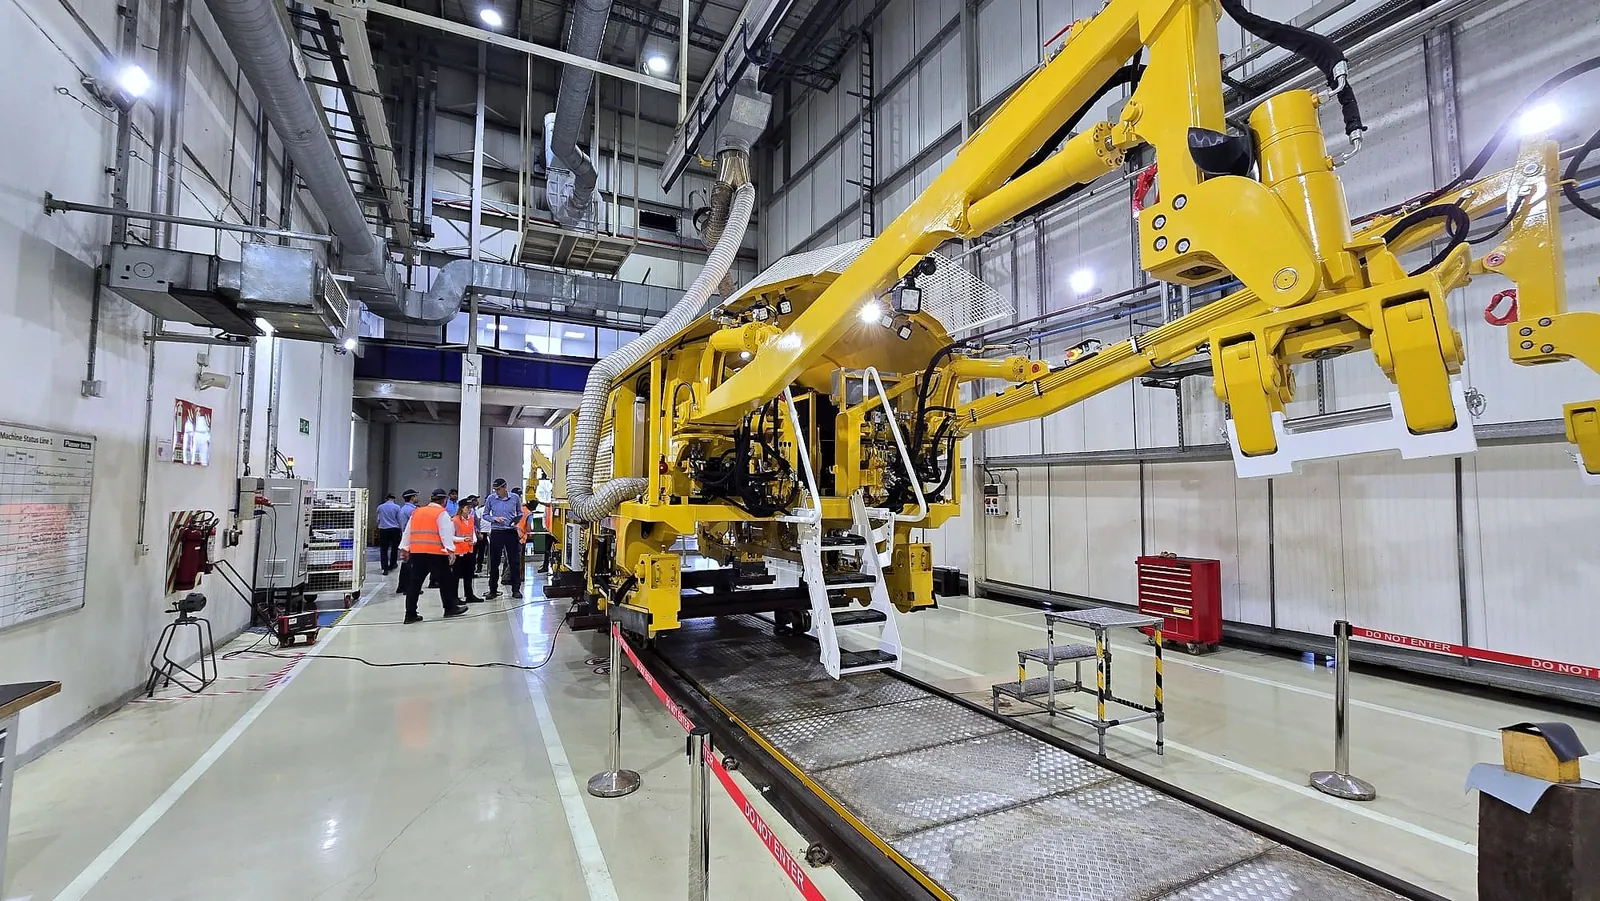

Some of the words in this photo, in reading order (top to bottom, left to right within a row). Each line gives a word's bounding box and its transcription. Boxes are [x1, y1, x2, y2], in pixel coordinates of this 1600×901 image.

[0, 431, 23, 442] Machine
[24, 434, 38, 444] Status
[40, 437, 49, 445] Line
[1366, 630, 1381, 639] DO
[1385, 633, 1407, 644] NOT
[1411, 639, 1451, 651] ENTER
[1532, 659, 1553, 669] DO
[1558, 664, 1592, 676] NOT
[703, 745, 714, 768] TER
[745, 802, 755, 823] DO
[757, 817, 773, 846] NOT
[774, 840, 804, 890] ENTER
